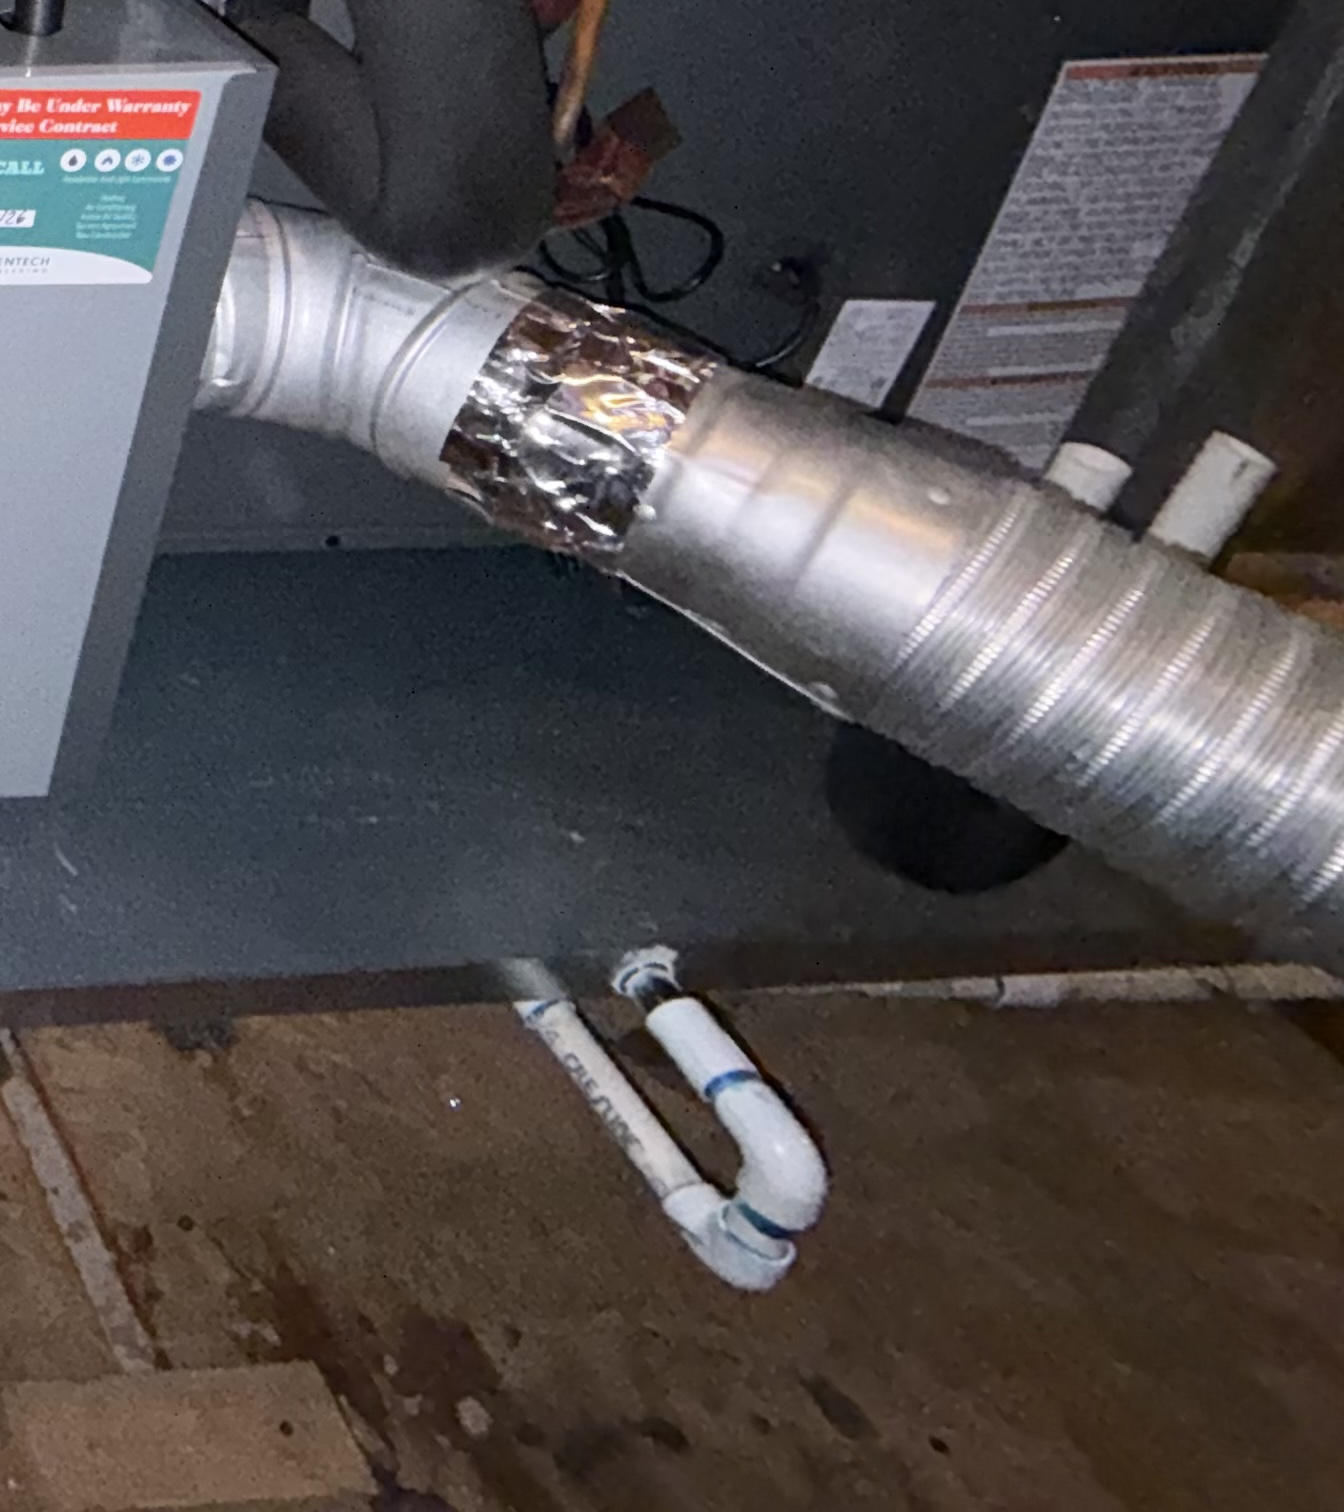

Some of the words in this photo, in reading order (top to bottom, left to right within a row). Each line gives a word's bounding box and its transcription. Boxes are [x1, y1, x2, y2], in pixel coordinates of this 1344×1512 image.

[17, 98, 41, 113] Be
[46, 98, 102, 113] Under
[106, 98, 191, 117] Warranty
[39, 118, 118, 133] Contract
